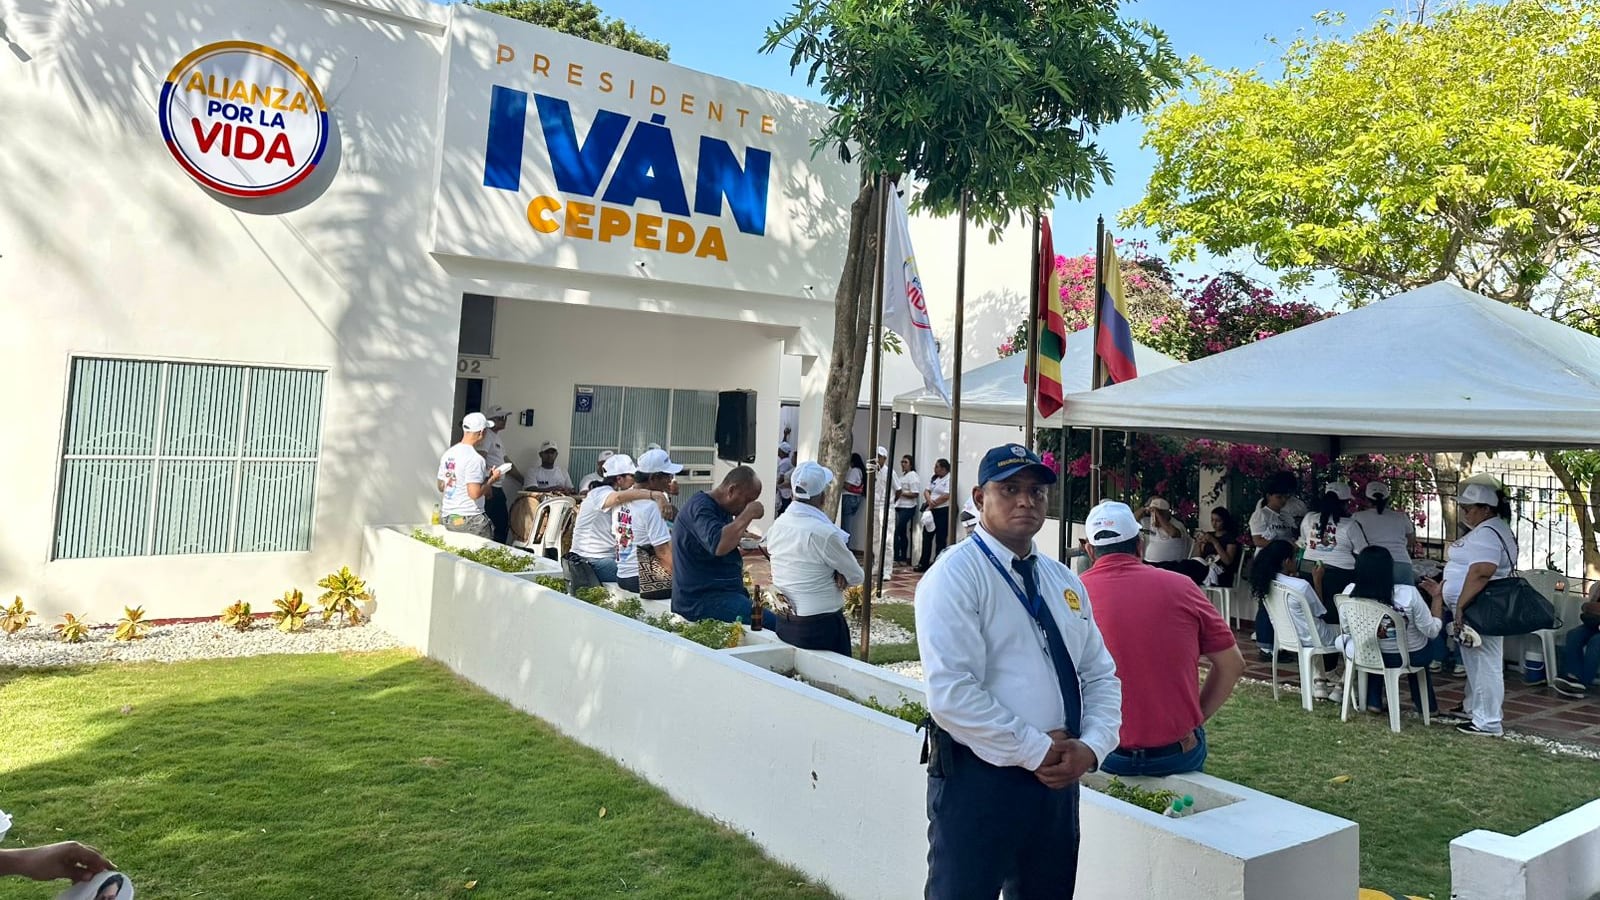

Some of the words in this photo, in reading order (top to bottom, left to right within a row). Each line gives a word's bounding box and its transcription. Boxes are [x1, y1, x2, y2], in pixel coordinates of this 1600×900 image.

[185, 71, 309, 115] ALIANZA
[207, 100, 253, 124] POR
[259, 109, 285, 130] LA
[496, 43, 775, 134] PRESIDENTE
[191, 117, 296, 168] VIDA
[483, 84, 772, 237] IVÁN
[526, 195, 729, 262] CEPEDA
